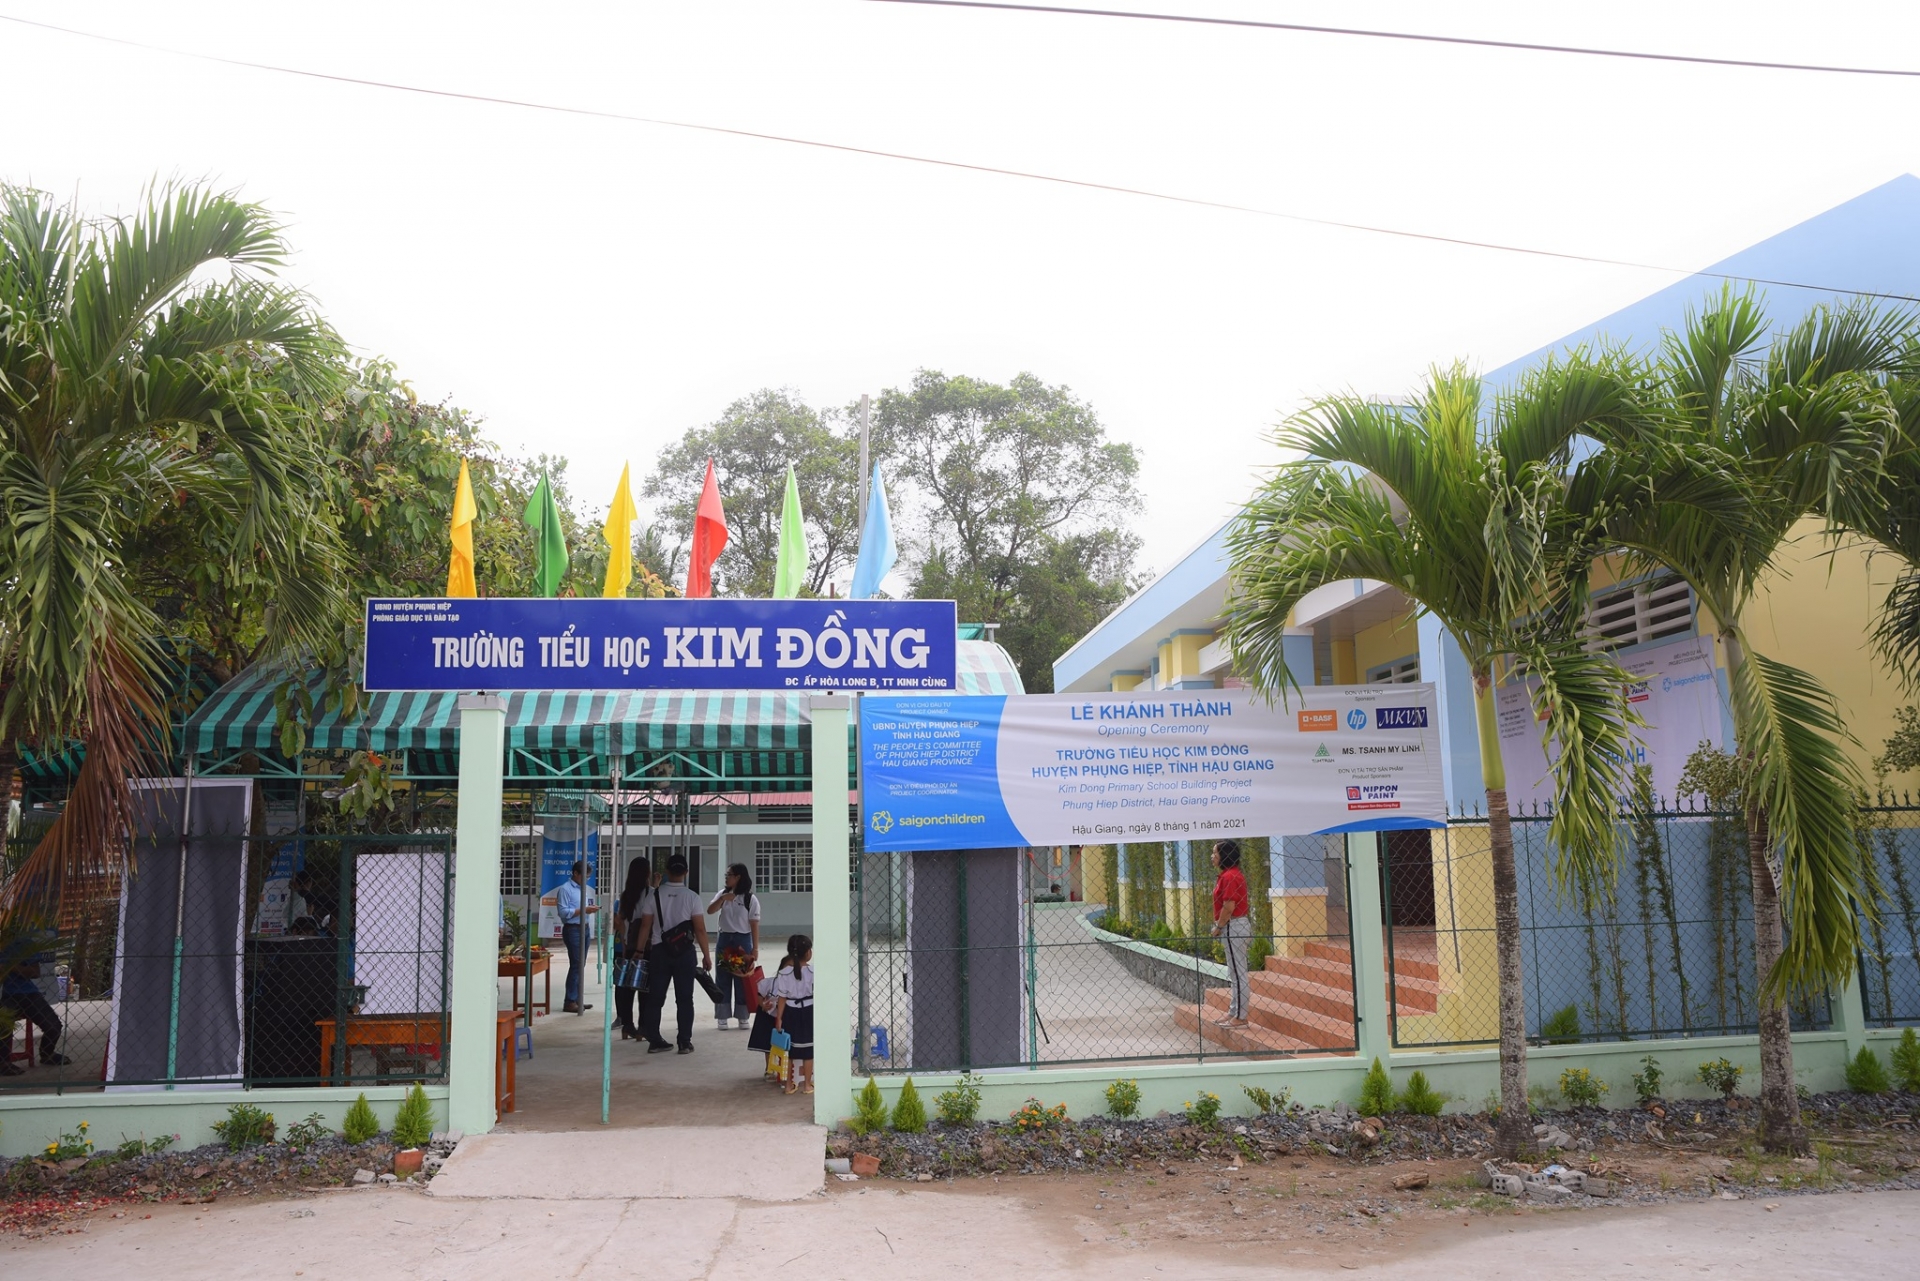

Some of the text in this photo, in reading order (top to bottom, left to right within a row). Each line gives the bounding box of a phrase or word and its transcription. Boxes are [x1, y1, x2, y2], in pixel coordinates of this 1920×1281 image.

[374, 602, 452, 612] UBND HUYỆN PHỤNG HIỆP
[372, 613, 394, 622] PHÒNG
[394, 613, 410, 622] GIÁO
[410, 614, 423, 623] DỤC
[424, 613, 433, 622] VÀ
[448, 614, 460, 622] TẠO
[432, 610, 930, 675] TRƯỜNG TIỂU HỌC KIM ĐỒNG
[785, 675, 948, 689] ĐC ẤP HÒA LONG B, TT KINH CÙNG
[1071, 698, 1232, 720] LỄ KHÁNH THÀNH
[1313, 714, 1333, 722] BASF
[1349, 709, 1366, 730] hp
[1378, 708, 1426, 727] MKVN
[872, 720, 980, 732] UBND HUYỆN PHỤNG HIỆP
[1098, 723, 1210, 738] Opening Ceremony
[934, 730, 961, 739] GIANG
[873, 740, 982, 751] THE PEOPLE'S COMMITTEE
[1056, 746, 1116, 761] TRƯỜNG
[1152, 746, 1181, 760] HỌC
[1184, 746, 1208, 758] KIM
[1211, 742, 1250, 756] ĐỒNG
[1342, 745, 1420, 755] MS. TSANH MY LINH
[875, 748, 980, 760] OF PHUNG HIEP DISTRICT
[882, 757, 973, 768] HAU GIANG PROVINCE
[1032, 763, 1078, 780] HUYỆN
[1082, 764, 1129, 779] PHỤNG
[1133, 762, 1166, 778] HIỆP,
[1202, 760, 1230, 775] HẬU
[1233, 759, 1275, 772] GIANG
[917, 788, 958, 796] COORDINATOR
[1058, 778, 1252, 795] Kim Dong Primary School Building Project
[1363, 784, 1398, 793] NIPPON
[1368, 792, 1395, 800] PAINT
[1062, 794, 1251, 812] Phung Hiep District, Hau Giang Province
[899, 813, 985, 827] saigonchildren
[1072, 818, 1246, 836] Hậu Giang, ngày 8 tháng 1 năm 2021
